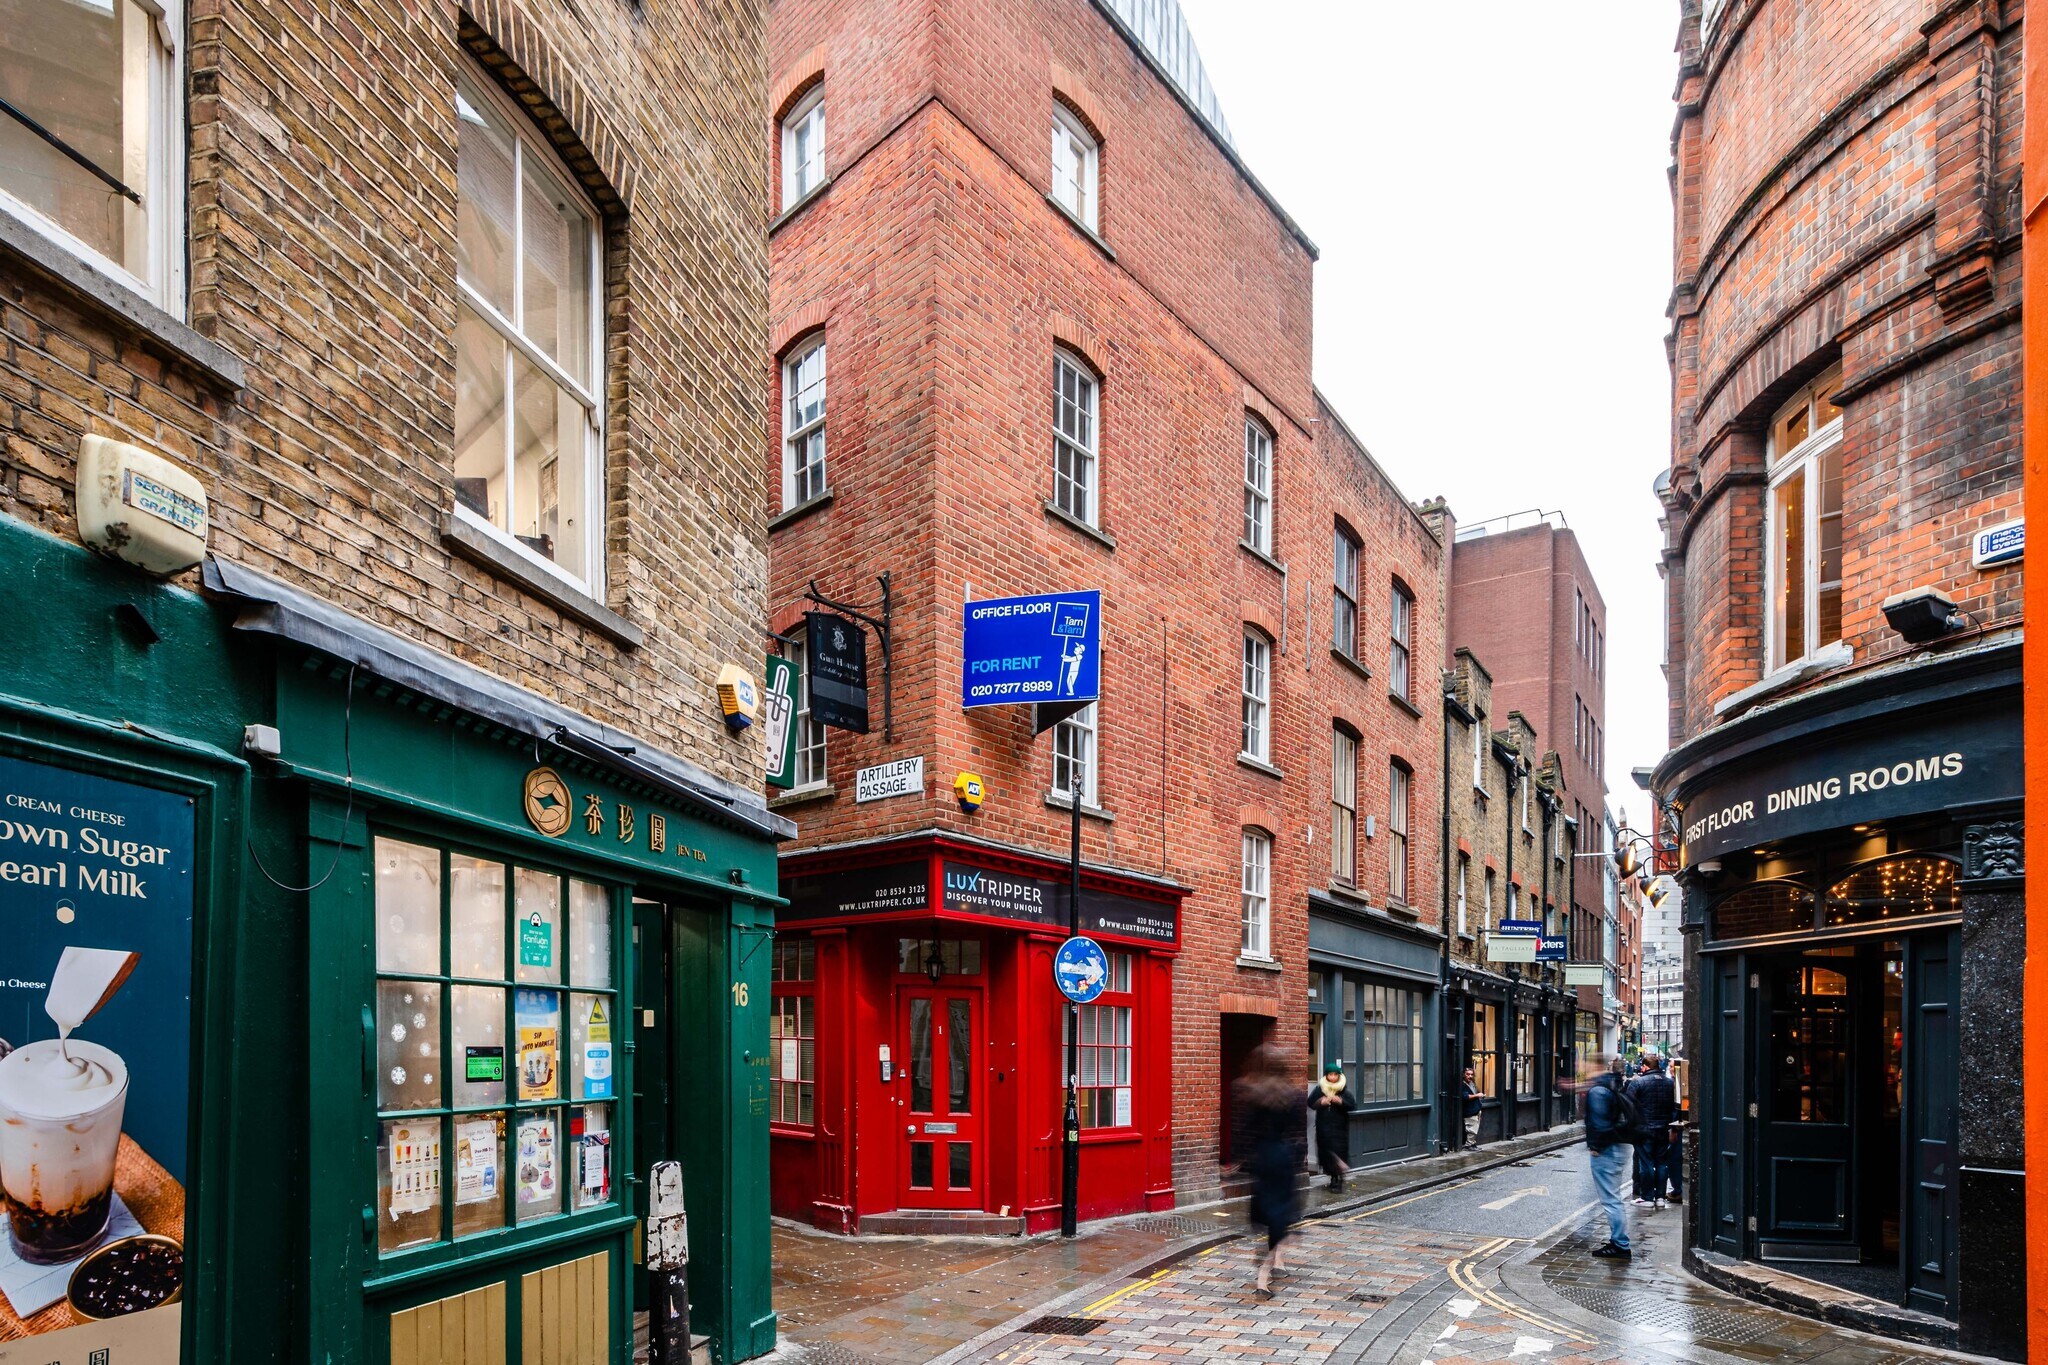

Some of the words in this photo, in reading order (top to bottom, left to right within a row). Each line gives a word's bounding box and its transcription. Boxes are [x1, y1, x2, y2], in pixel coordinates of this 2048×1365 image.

[139, 497, 198, 529] GRANLEY
[972, 605, 1012, 620] OFFICE
[1013, 602, 1052, 616] FLOOR
[1057, 624, 1082, 634] &Tarn
[1064, 615, 1084, 626] Tarn
[971, 659, 999, 674] FOR
[1002, 656, 1042, 671] RENT
[740, 685, 753, 702] ADT
[971, 684, 993, 696] 020
[994, 682, 1021, 694] 7377
[1022, 680, 1053, 692] 8989
[860, 758, 919, 783] ARTILLERY
[860, 778, 907, 799] PASSAGE
[969, 784, 980, 795] ADT
[1685, 817, 1707, 846] FIRST
[1707, 800, 1755, 833] FLOOR
[1767, 777, 1841, 815] DINING
[1848, 752, 1964, 795] ROOMS
[6, 794, 62, 815] CREAM
[70, 806, 126, 827] CHEESE
[583, 793, 666, 853] 茶珍圓
[79, 827, 171, 867] Sugar
[677, 844, 690, 857] JEN
[692, 849, 707, 862] TEA
[78, 865, 147, 899] Milk
[875, 888, 887, 897] 020
[889, 887, 906, 896] 8534
[908, 884, 926, 894] 3125
[947, 871, 1043, 905] LUXTRIPPER
[839, 896, 926, 911] WWW.LUXTRIPPER.CO.UK
[946, 891, 987, 905] DISCOVER
[990, 898, 1011, 909] YOUR
[1014, 902, 1043, 914] UNIQUE
[1106, 920, 1173, 937] WWW.LUXTRIPPER.CO.UK
[1137, 917, 1147, 925] 020
[1148, 919, 1160, 927] 8534
[1161, 921, 1173, 929] 3125
[1540, 940, 1564, 949] xters
[8, 979, 46, 989] Cheese
[732, 982, 749, 1007] 16
[534, 1031, 542, 1039] SIP
[938, 1025, 943, 1035] 1
[495, 1067, 500, 1075] 5
